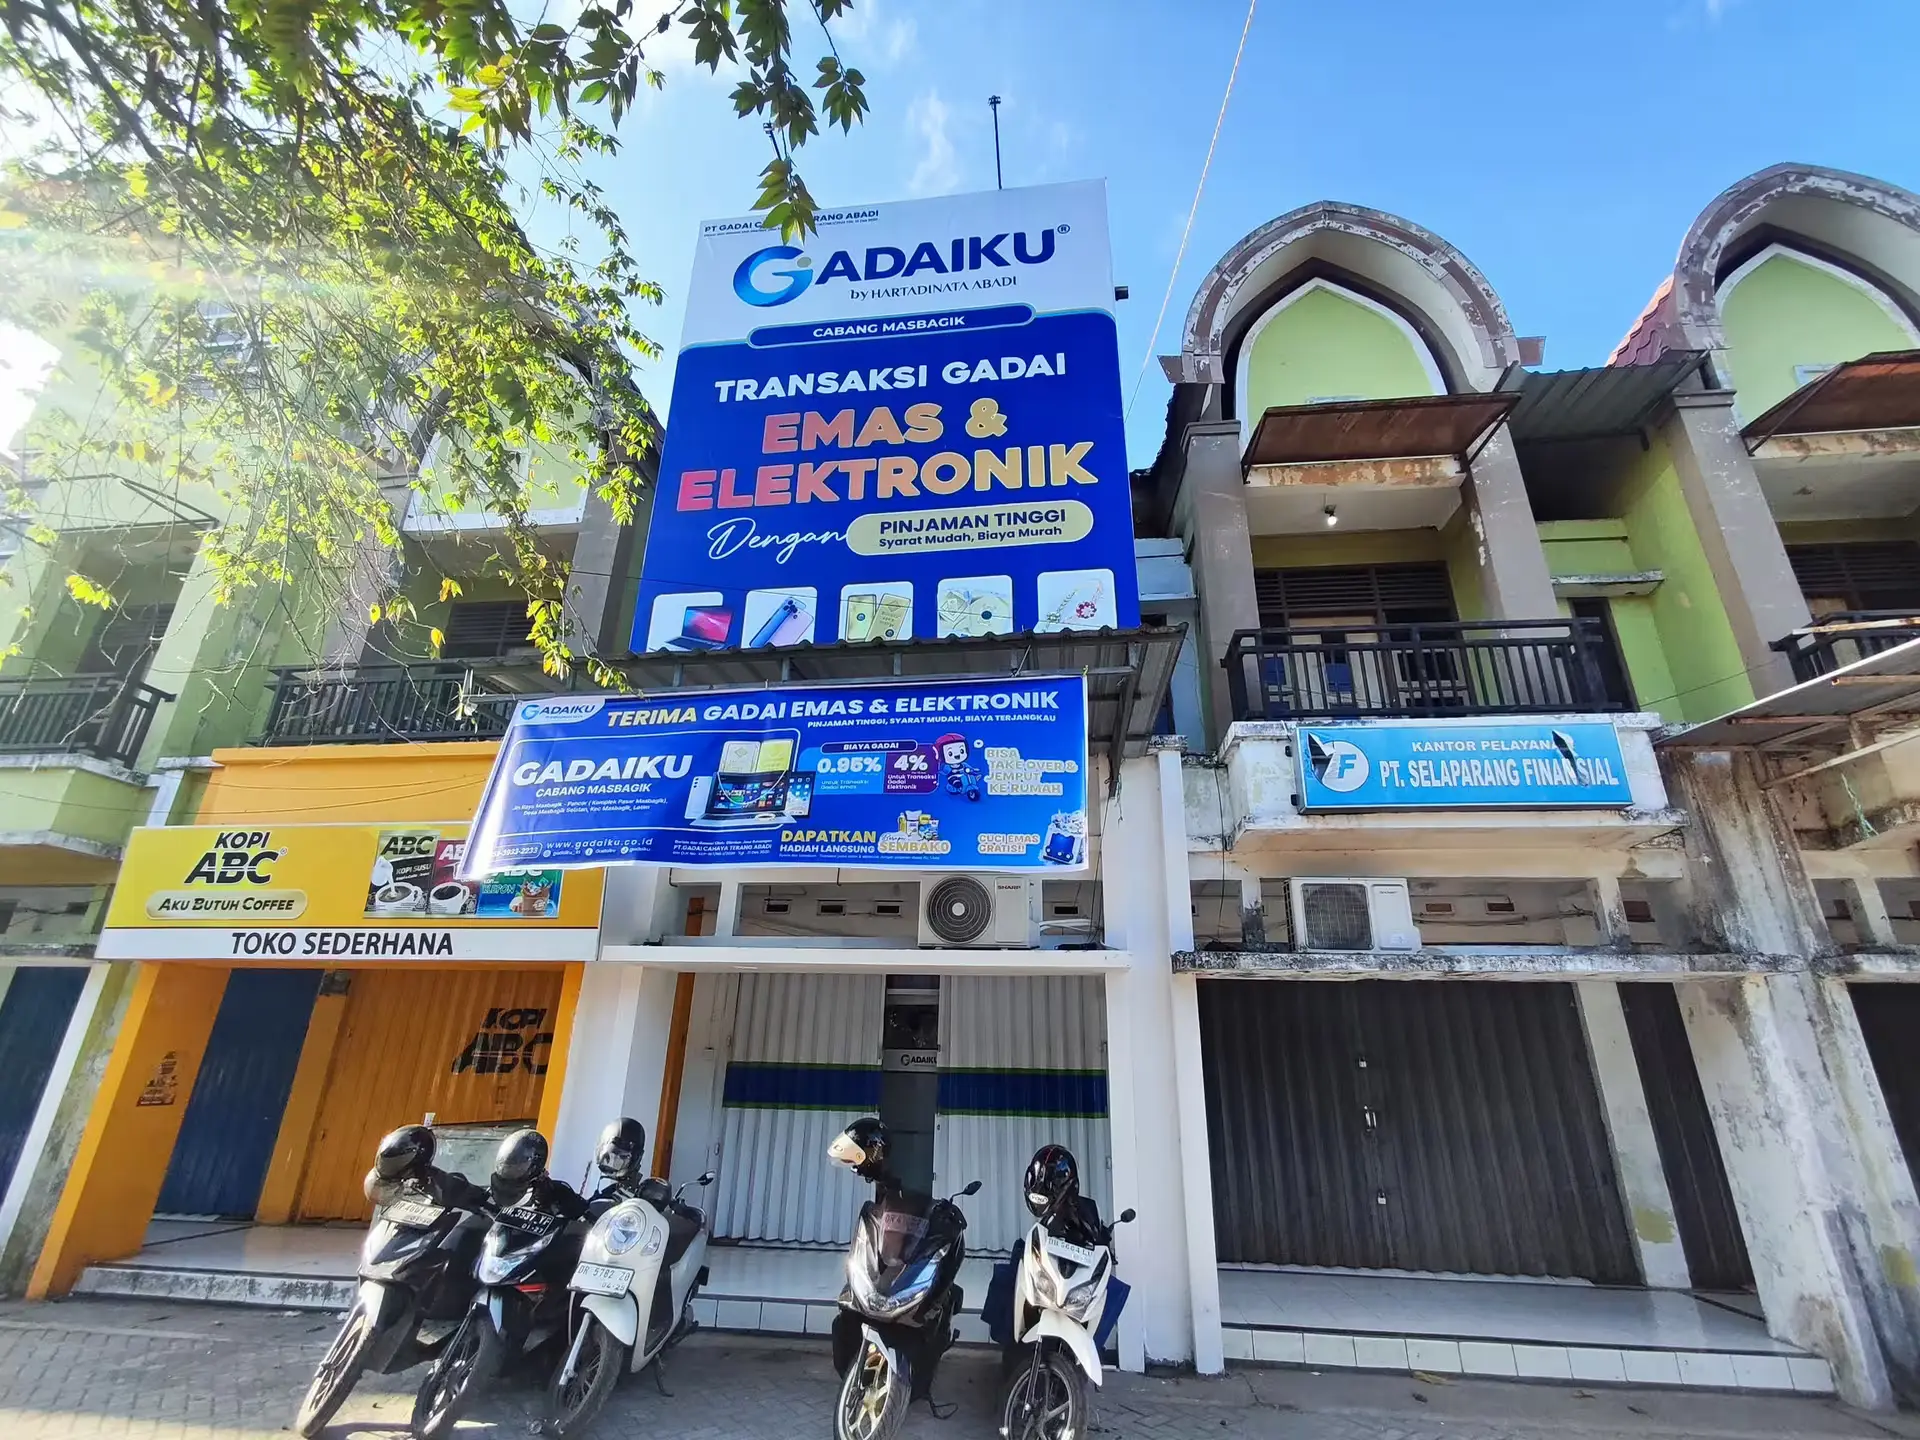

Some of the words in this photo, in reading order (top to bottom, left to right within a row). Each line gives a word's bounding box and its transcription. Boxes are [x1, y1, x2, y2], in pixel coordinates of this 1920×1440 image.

[704, 225, 717, 233] PT
[719, 222, 752, 232] GADAI
[814, 213, 844, 222] RANG
[846, 210, 879, 220] ABADI
[733, 229, 1056, 307] GADAIKU
[850, 288, 868, 301] by
[871, 281, 969, 300] HARTADINATA
[971, 275, 1018, 291] ABADI
[812, 323, 879, 338] CABANG
[882, 315, 966, 333] MASBAGIK
[714, 364, 928, 402] TRANSAKSI
[941, 352, 1067, 385] GADAI
[761, 402, 944, 454] EMAS
[965, 397, 1008, 438] &
[676, 441, 1098, 512] ELEKTRONIK
[879, 514, 989, 534] PINJAMAN
[993, 508, 1067, 528] TINGGI
[706, 517, 848, 565] Dengan
[878, 535, 923, 548] Syarat
[924, 531, 975, 546] Mudah,
[977, 528, 1016, 543] Biaya
[1018, 525, 1062, 538] Murah
[521, 704, 595, 720] GADAIKU
[607, 708, 696, 727] TERIMA
[703, 702, 786, 721] GADAI
[790, 700, 864, 718] EMAS
[868, 699, 889, 714] &
[895, 691, 1059, 712] ELEKTRONIK
[807, 719, 855, 728] PINJAMAN
[855, 718, 889, 727] TINGGI,
[890, 716, 926, 724] SYARAT
[927, 715, 964, 724] MUDAH,
[965, 714, 993, 723] BIAYA
[994, 713, 1056, 723] TERJANGKAU
[843, 743, 870, 751] BIAYA
[987, 749, 1017, 758] BISA
[1412, 740, 1477, 753] KANTOR
[1481, 739, 1566, 752] PELAYAN
[513, 755, 693, 786] GADAIKU
[894, 754, 928, 771] 4%
[989, 760, 1024, 769] TAKE
[1027, 760, 1064, 771] OVER
[1066, 761, 1076, 770] &
[987, 772, 1040, 781] JEMPUT
[1379, 760, 1405, 788] PT.
[1408, 759, 1519, 788] SELAPARANG
[1523, 757, 1619, 787] FINANSIAL
[535, 786, 585, 798] CABANG
[587, 783, 652, 795] MASBAGIK
[990, 783, 1008, 793] KE
[1011, 783, 1061, 793] RUMAH
[214, 831, 271, 849] KOPI
[381, 836, 434, 855] ABC
[547, 838, 654, 850] www.gadaiku.co.id
[781, 830, 876, 843] DAPATKAN
[439, 844, 465, 861] AB
[780, 844, 819, 852] HADIAH
[820, 844, 875, 853] LANGSUNG
[880, 841, 949, 853] SEMBAKO
[184, 850, 280, 884] ABC
[158, 898, 191, 911] AKU
[192, 898, 239, 911] BUTUH
[243, 897, 295, 911] COFFEE
[231, 932, 298, 956] TOKO
[302, 932, 454, 956] SEDERHANA
[482, 1008, 547, 1030] KOPI
